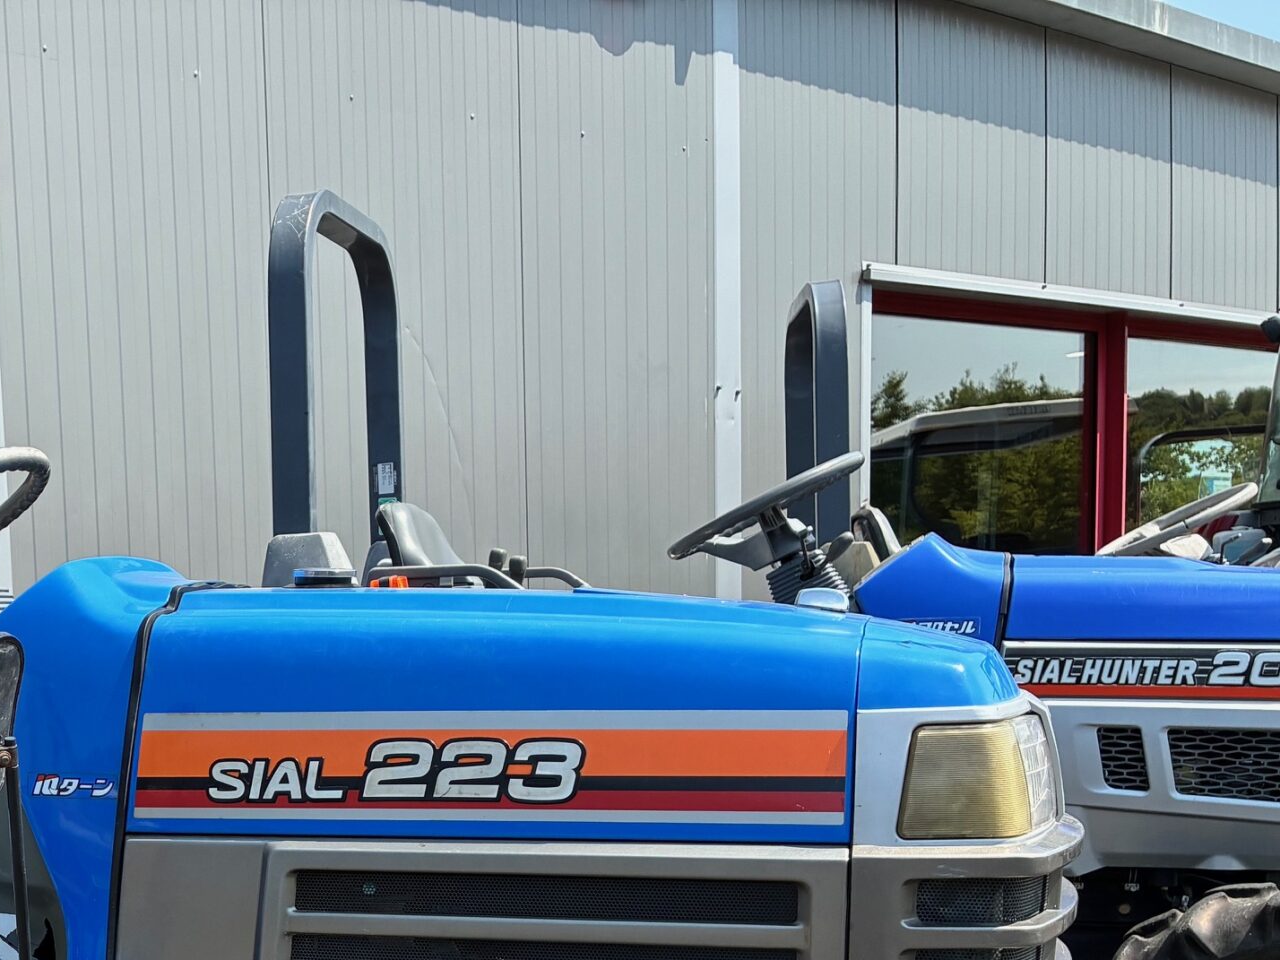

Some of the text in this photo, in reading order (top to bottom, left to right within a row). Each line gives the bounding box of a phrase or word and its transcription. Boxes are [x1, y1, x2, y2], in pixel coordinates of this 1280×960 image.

[1015, 658, 1077, 685] SIAL
[1080, 658, 1197, 686] HUNTER
[207, 737, 586, 804] SIAL 223
